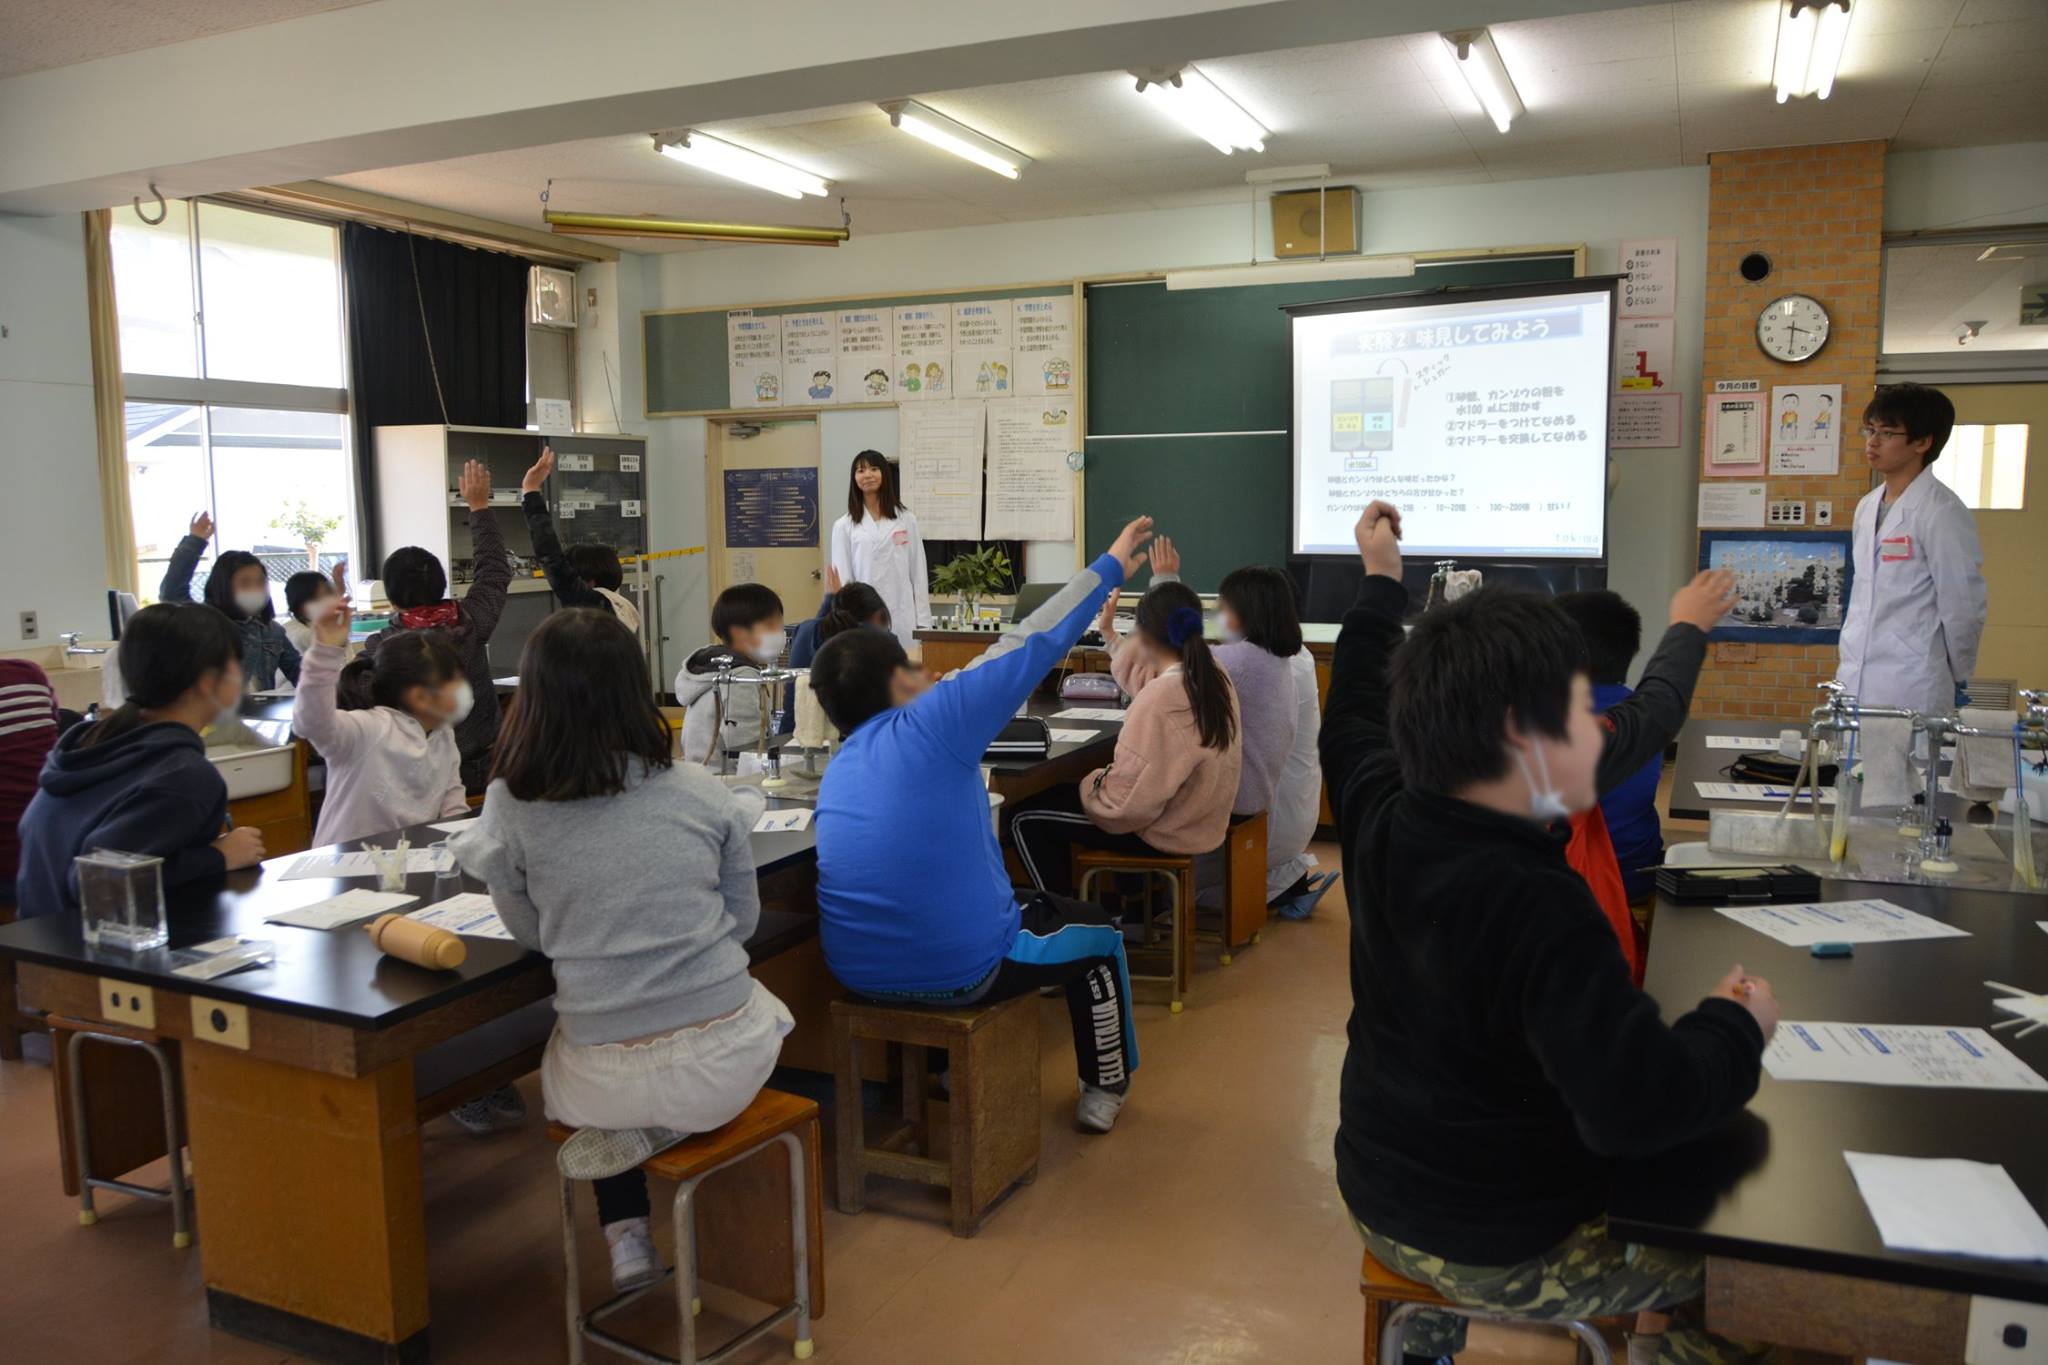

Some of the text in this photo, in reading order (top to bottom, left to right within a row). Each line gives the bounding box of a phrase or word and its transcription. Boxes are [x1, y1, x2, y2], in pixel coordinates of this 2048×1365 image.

[1416, 318, 1551, 349] 味見してみよう
[1717, 382, 1757, 391] 今月の目標
[1091, 997, 1122, 1051] ITALIA
